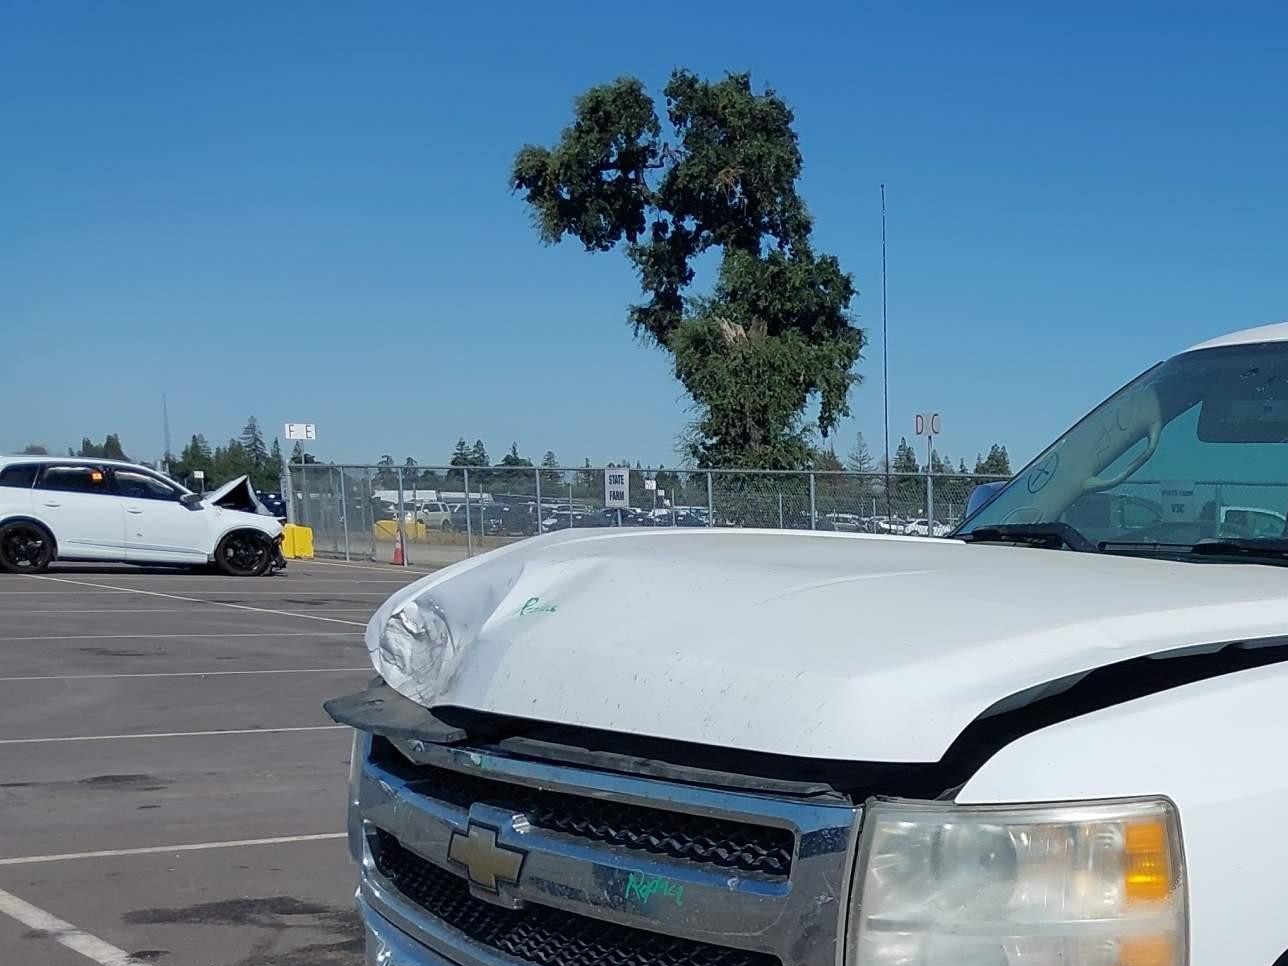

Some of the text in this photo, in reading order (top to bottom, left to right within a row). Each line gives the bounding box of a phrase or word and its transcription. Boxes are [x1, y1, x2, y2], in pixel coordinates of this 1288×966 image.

[915, 412, 939, 436] D C
[288, 424, 313, 439] F E
[608, 474, 625, 486] STATE
[609, 490, 625, 501] FARM
